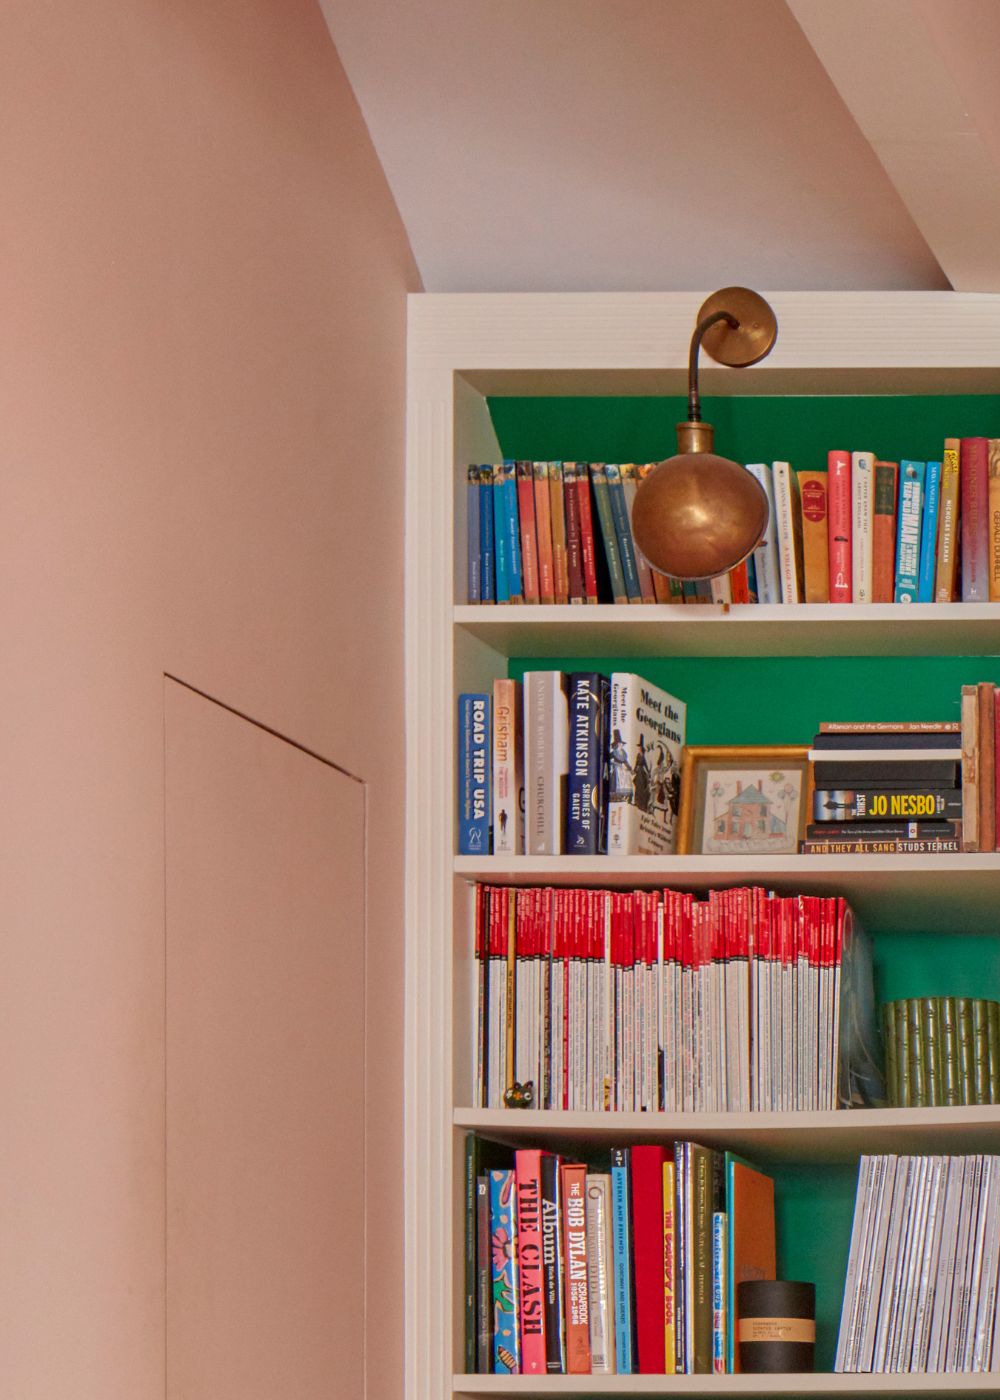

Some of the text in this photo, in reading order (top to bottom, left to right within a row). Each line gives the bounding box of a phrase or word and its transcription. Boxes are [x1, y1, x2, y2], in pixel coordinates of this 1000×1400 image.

[900, 513, 919, 546] MAN
[944, 499, 953, 532] NICHOLAS
[611, 683, 620, 727] Georgians
[620, 686, 628, 723] Meet the
[640, 689, 680, 723] Meet the
[496, 706, 511, 762] Grisham
[575, 679, 590, 777] KATE ATKINSON
[636, 708, 682, 744] Georgians
[473, 700, 485, 820] ROAD TRIP USA
[536, 776, 545, 837] CHURCHILL
[571, 792, 581, 821] GAIETY
[581, 783, 591, 830] SHRINES OF
[856, 794, 866, 817] THIRST
[869, 795, 936, 816] JO NESBO
[810, 841, 958, 853] AND THEY ALL SANG STUDS TERKEL
[541, 1198, 557, 1265] Album
[665, 1210, 673, 1229] THE
[519, 1178, 543, 1336] THE CLASH
[567, 1182, 588, 1325] THE BOB DYLAN SCRAPBOOK
